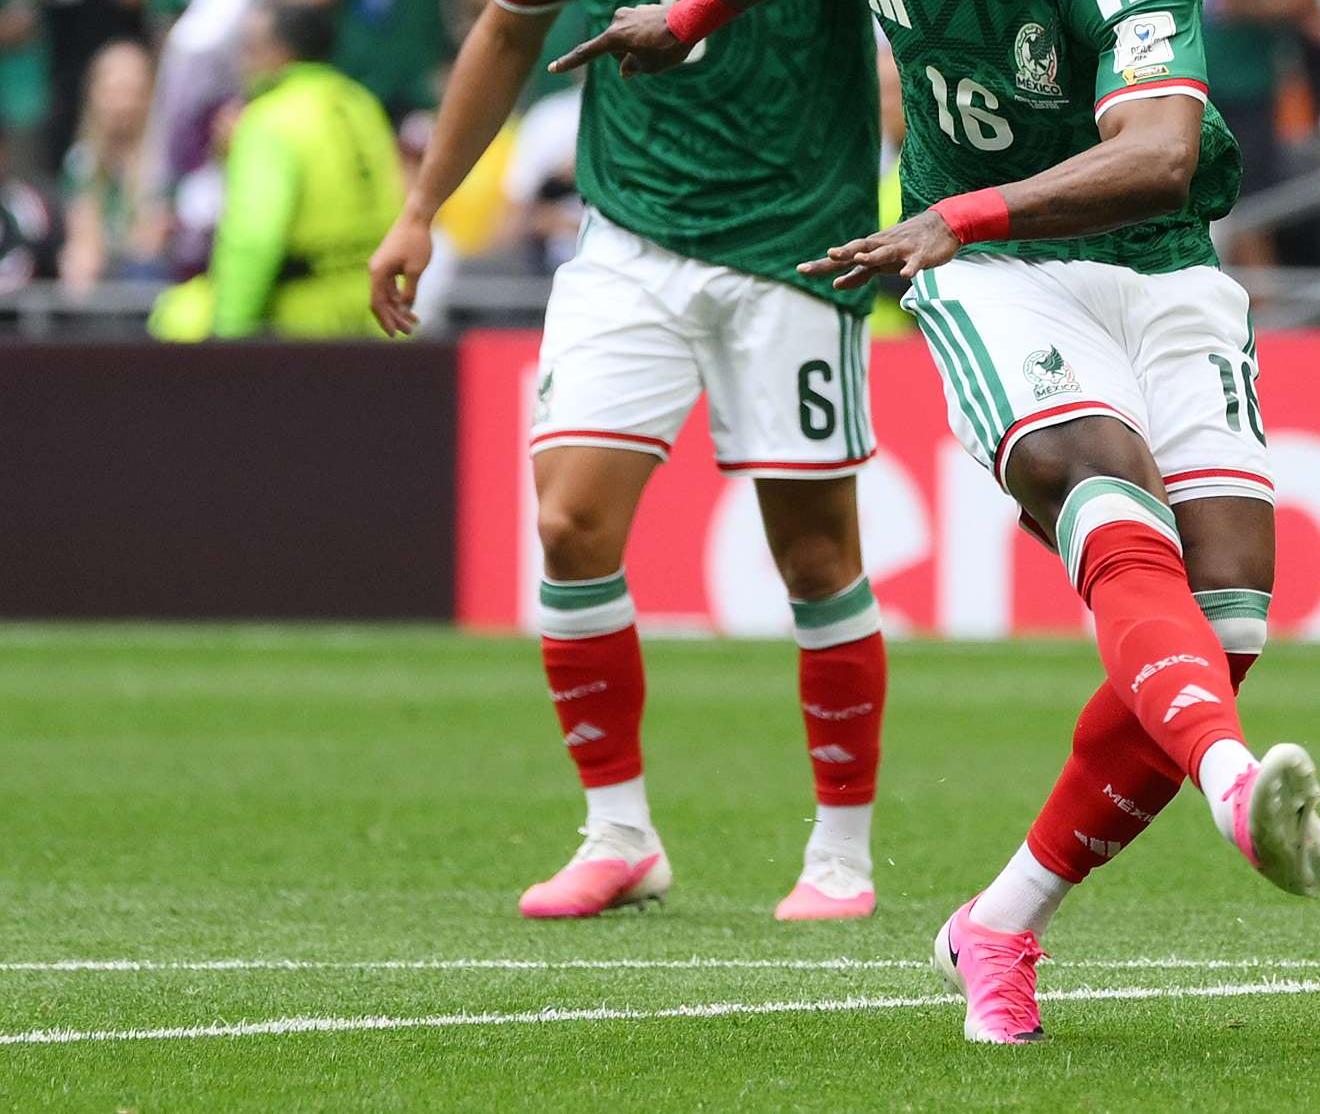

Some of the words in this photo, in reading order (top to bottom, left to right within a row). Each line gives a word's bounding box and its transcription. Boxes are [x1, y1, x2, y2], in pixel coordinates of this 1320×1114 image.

[925, 64, 1014, 152] 16
[798, 358, 836, 441] 6
[1130, 654, 1210, 694] MÉXICO
